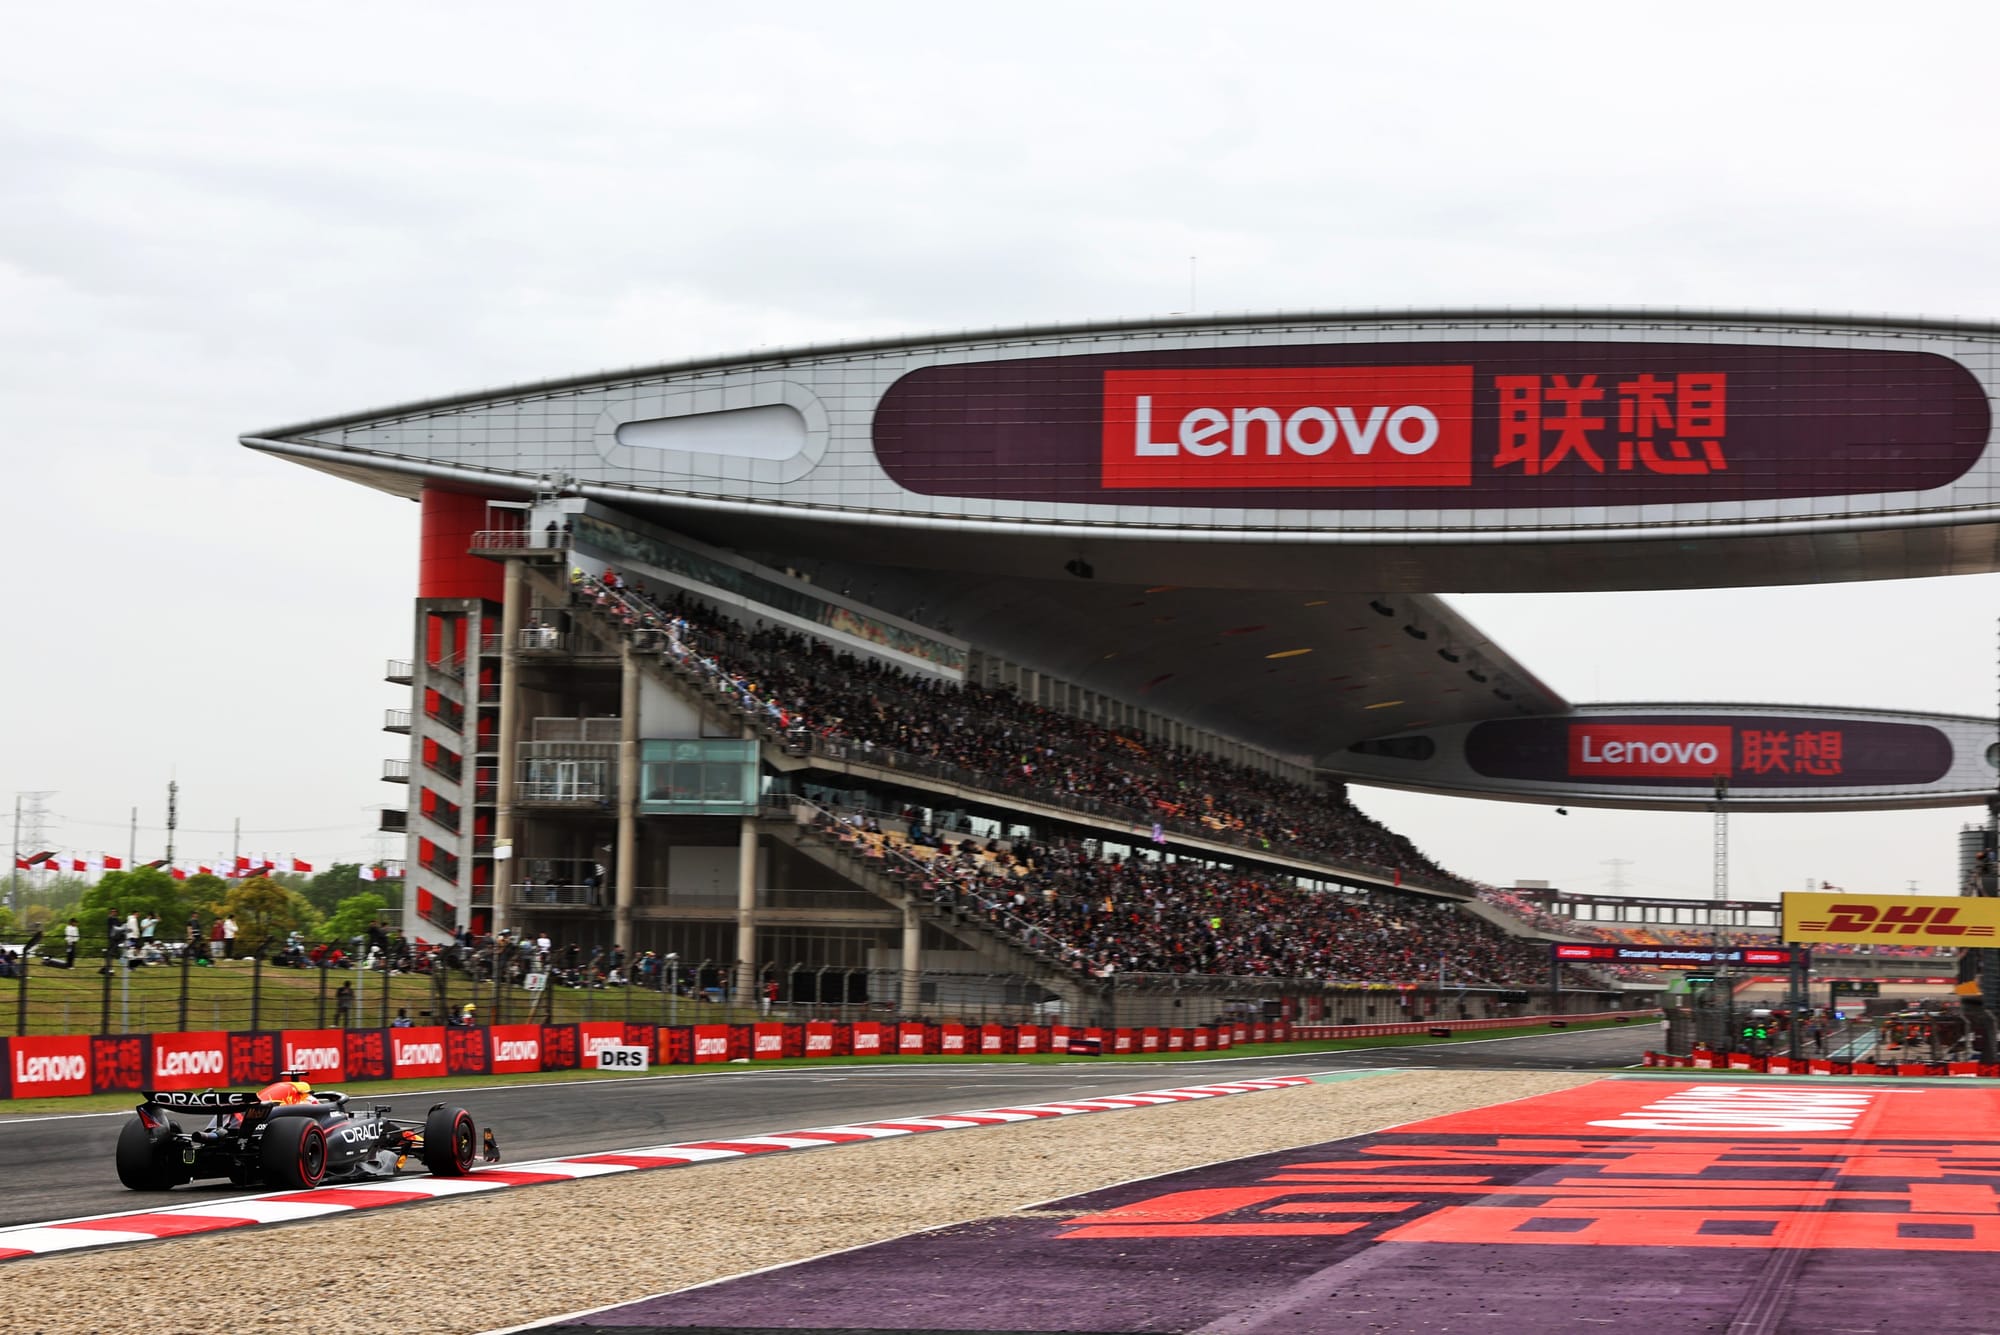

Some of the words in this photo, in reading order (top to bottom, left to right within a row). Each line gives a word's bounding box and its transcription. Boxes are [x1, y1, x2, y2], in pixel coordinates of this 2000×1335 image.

[1134, 395, 1440, 457] Lenovo
[1492, 373, 1728, 476] 联想
[1582, 735, 1718, 764] Lenovo
[1740, 730, 1843, 775] 联想
[1825, 904, 1968, 936] DHL
[156, 1046, 224, 1077] Lenovo
[286, 1042, 340, 1071] Lenovo
[393, 1039, 443, 1066] Lenovo
[493, 1036, 539, 1062] Lenovo
[602, 1051, 642, 1066] DRS
[16, 1050, 86, 1083] Lenovo
[152, 1093, 244, 1107] ORACLE
